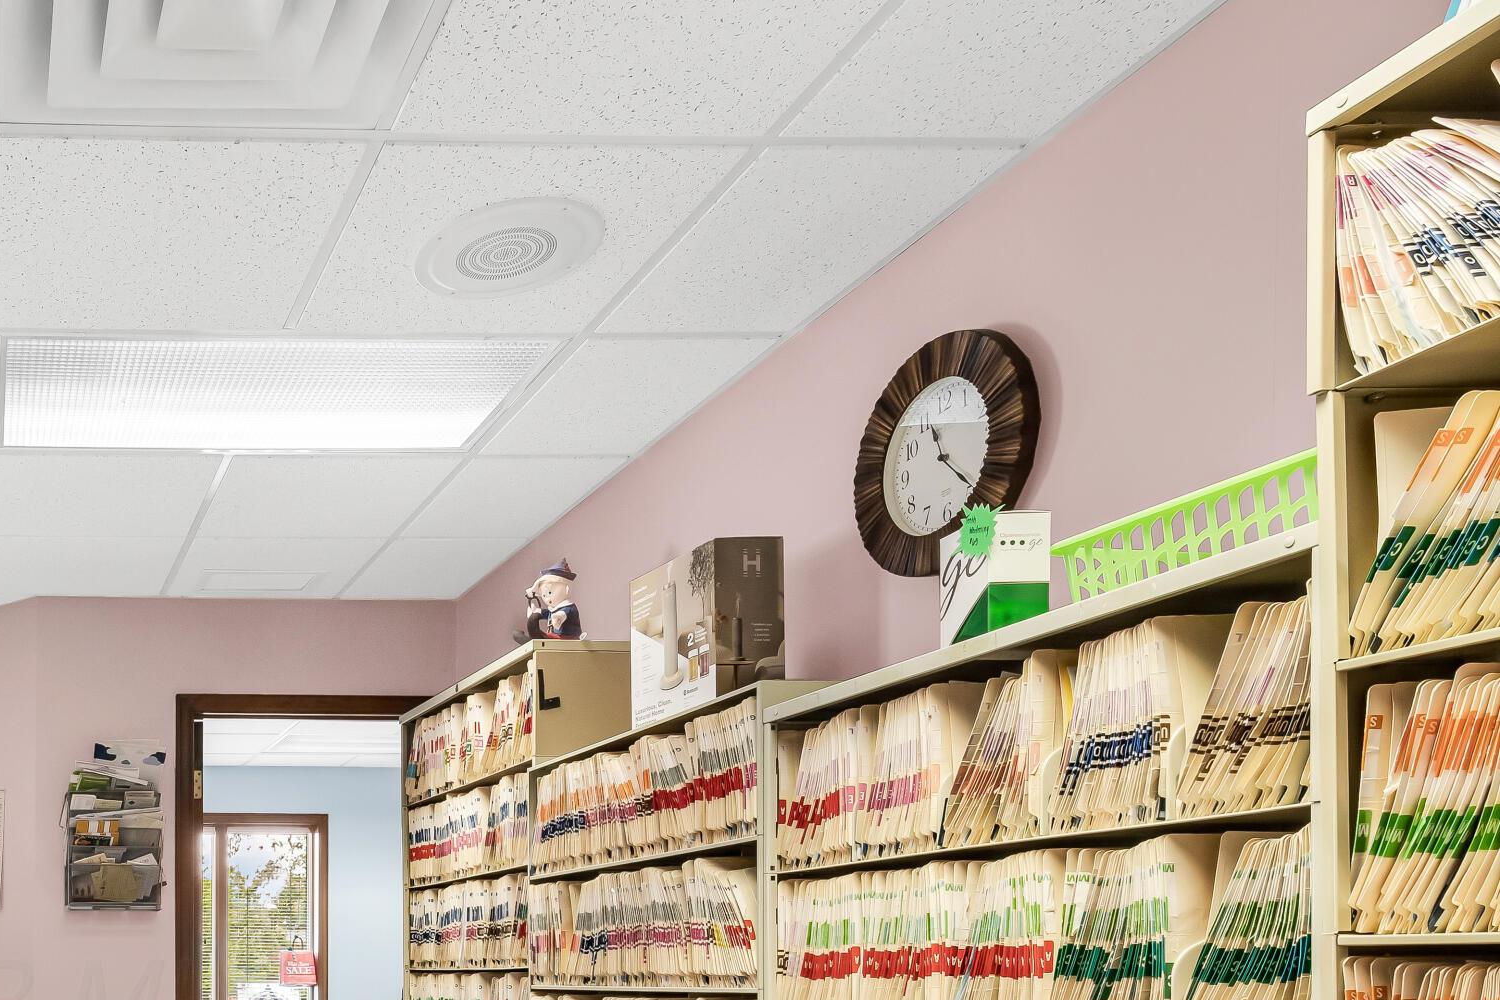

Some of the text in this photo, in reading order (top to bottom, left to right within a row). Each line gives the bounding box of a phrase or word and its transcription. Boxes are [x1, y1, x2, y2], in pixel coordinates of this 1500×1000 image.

[938, 390, 952, 415] 12
[963, 389, 967, 407] 1
[921, 412, 929, 434] 11
[906, 439, 919, 461] 10
[901, 471, 910, 490] 9
[908, 495, 915, 515] 8
[943, 502, 952, 523] 6
[923, 506, 931, 525] 7
[687, 633, 694, 647] 2
[286, 966, 312, 974] SALE
